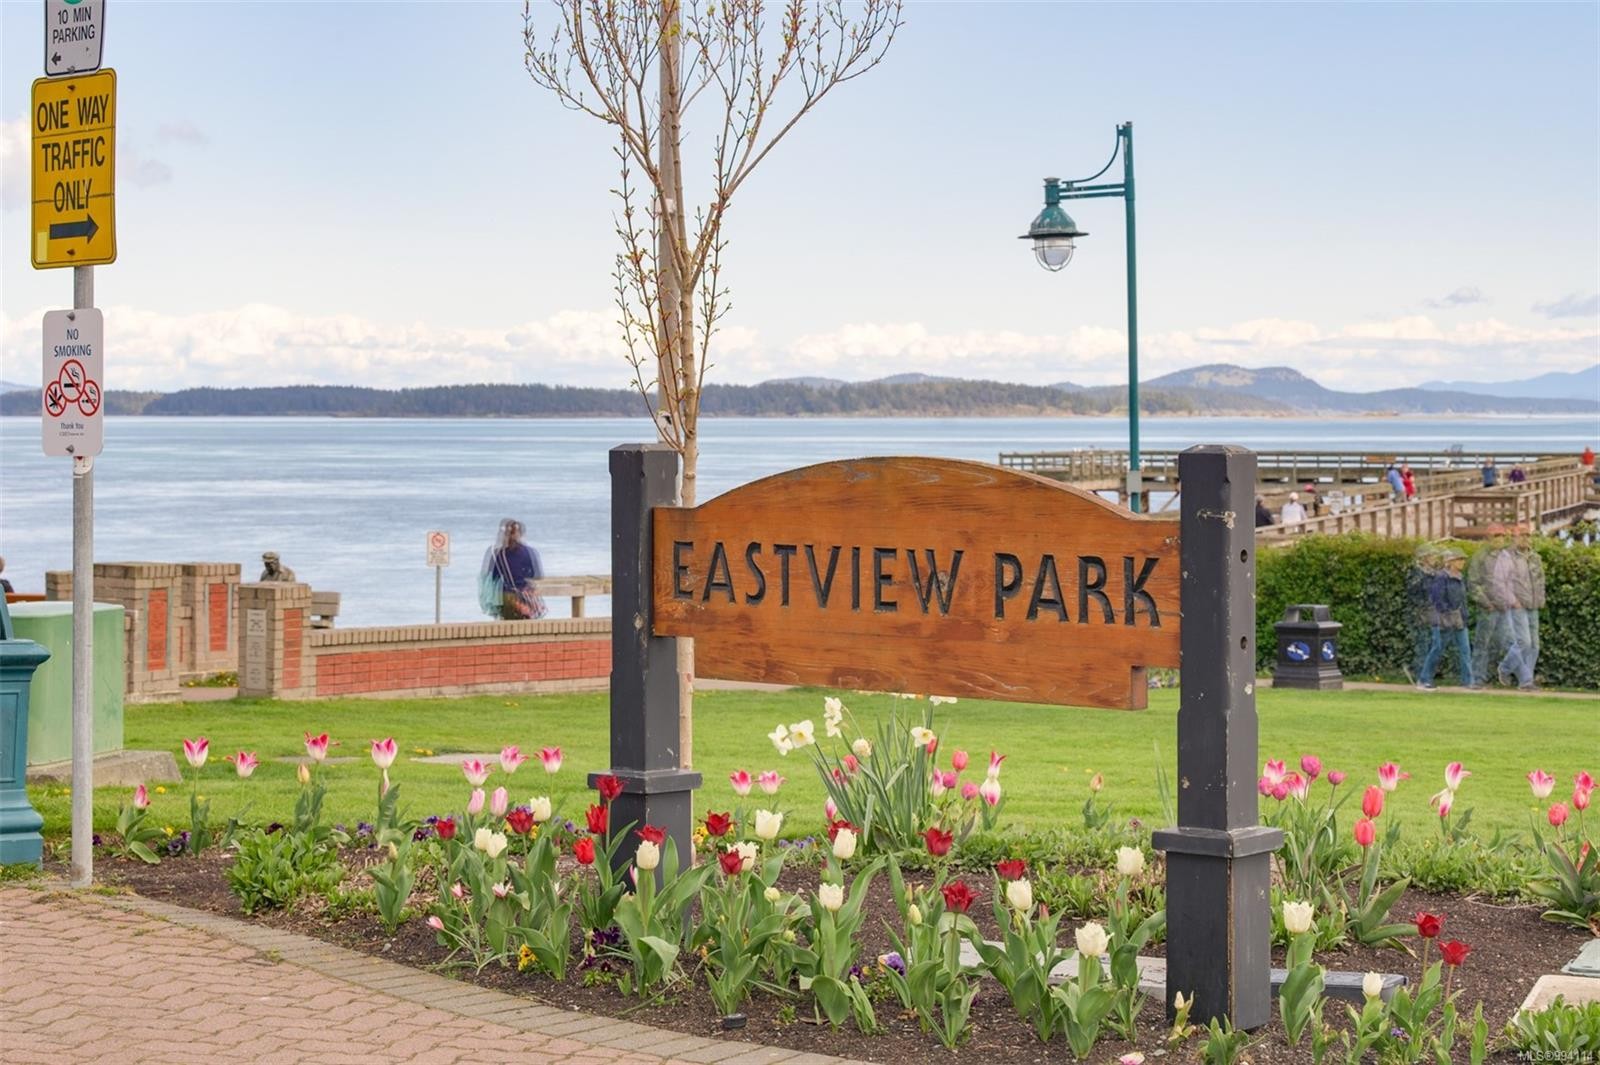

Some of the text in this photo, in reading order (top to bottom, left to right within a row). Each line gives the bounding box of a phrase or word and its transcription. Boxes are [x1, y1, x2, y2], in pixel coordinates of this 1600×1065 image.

[57, 6, 92, 25] 10 MIN
[52, 23, 96, 45] PARKING
[37, 93, 109, 133] ONE WAY
[42, 135, 105, 173] TRAFFIC
[54, 178, 92, 213] ONLY
[66, 328, 79, 341] NO
[54, 344, 92, 358] SMOKING
[672, 539, 1162, 629] EASTVIEW PARK
